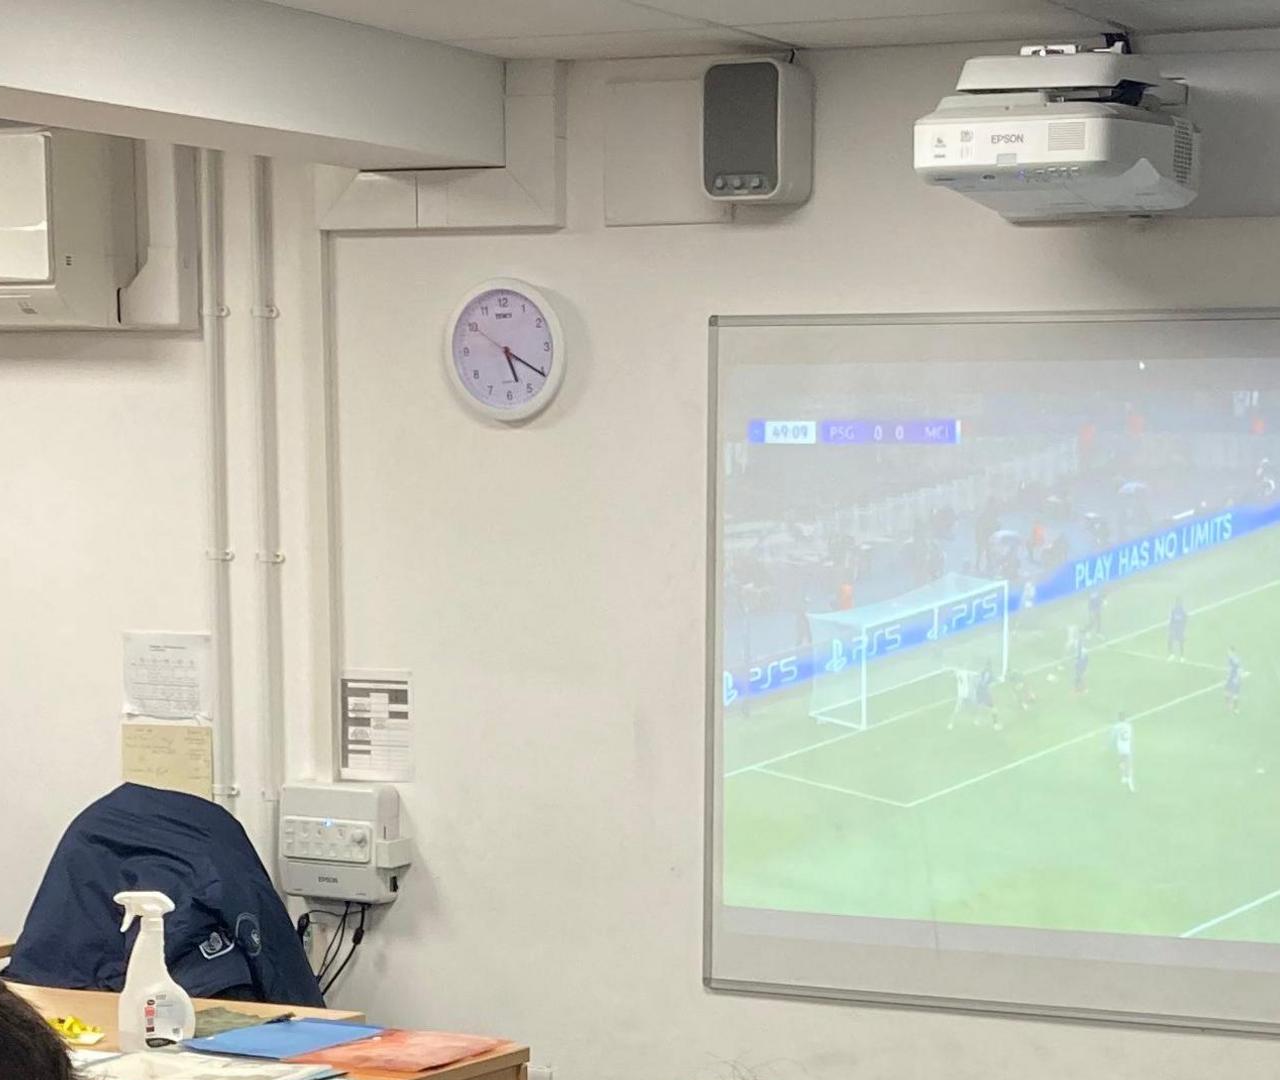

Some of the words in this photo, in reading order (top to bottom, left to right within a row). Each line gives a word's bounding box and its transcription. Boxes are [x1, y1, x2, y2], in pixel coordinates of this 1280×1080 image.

[991, 134, 1024, 144] EPSON
[497, 297, 509, 308] 12
[481, 306, 489, 317] 11
[521, 304, 526, 313] 1
[535, 317, 542, 329] 2
[543, 341, 551, 352] 3
[473, 369, 480, 380] 8
[487, 385, 494, 396] 7
[526, 382, 533, 394] 5
[506, 390, 513, 401] 6
[830, 425, 855, 440] PSG
[873, 424, 883, 440] 0
[895, 424, 905, 440] 0
[924, 425, 950, 439] MCI
[1075, 553, 1113, 589] PLAY
[1118, 541, 1150, 577] HAS
[1154, 531, 1178, 563] NO
[1182, 513, 1233, 554] LIMITS
[951, 594, 998, 628] PS5
[750, 655, 798, 690] PS5
